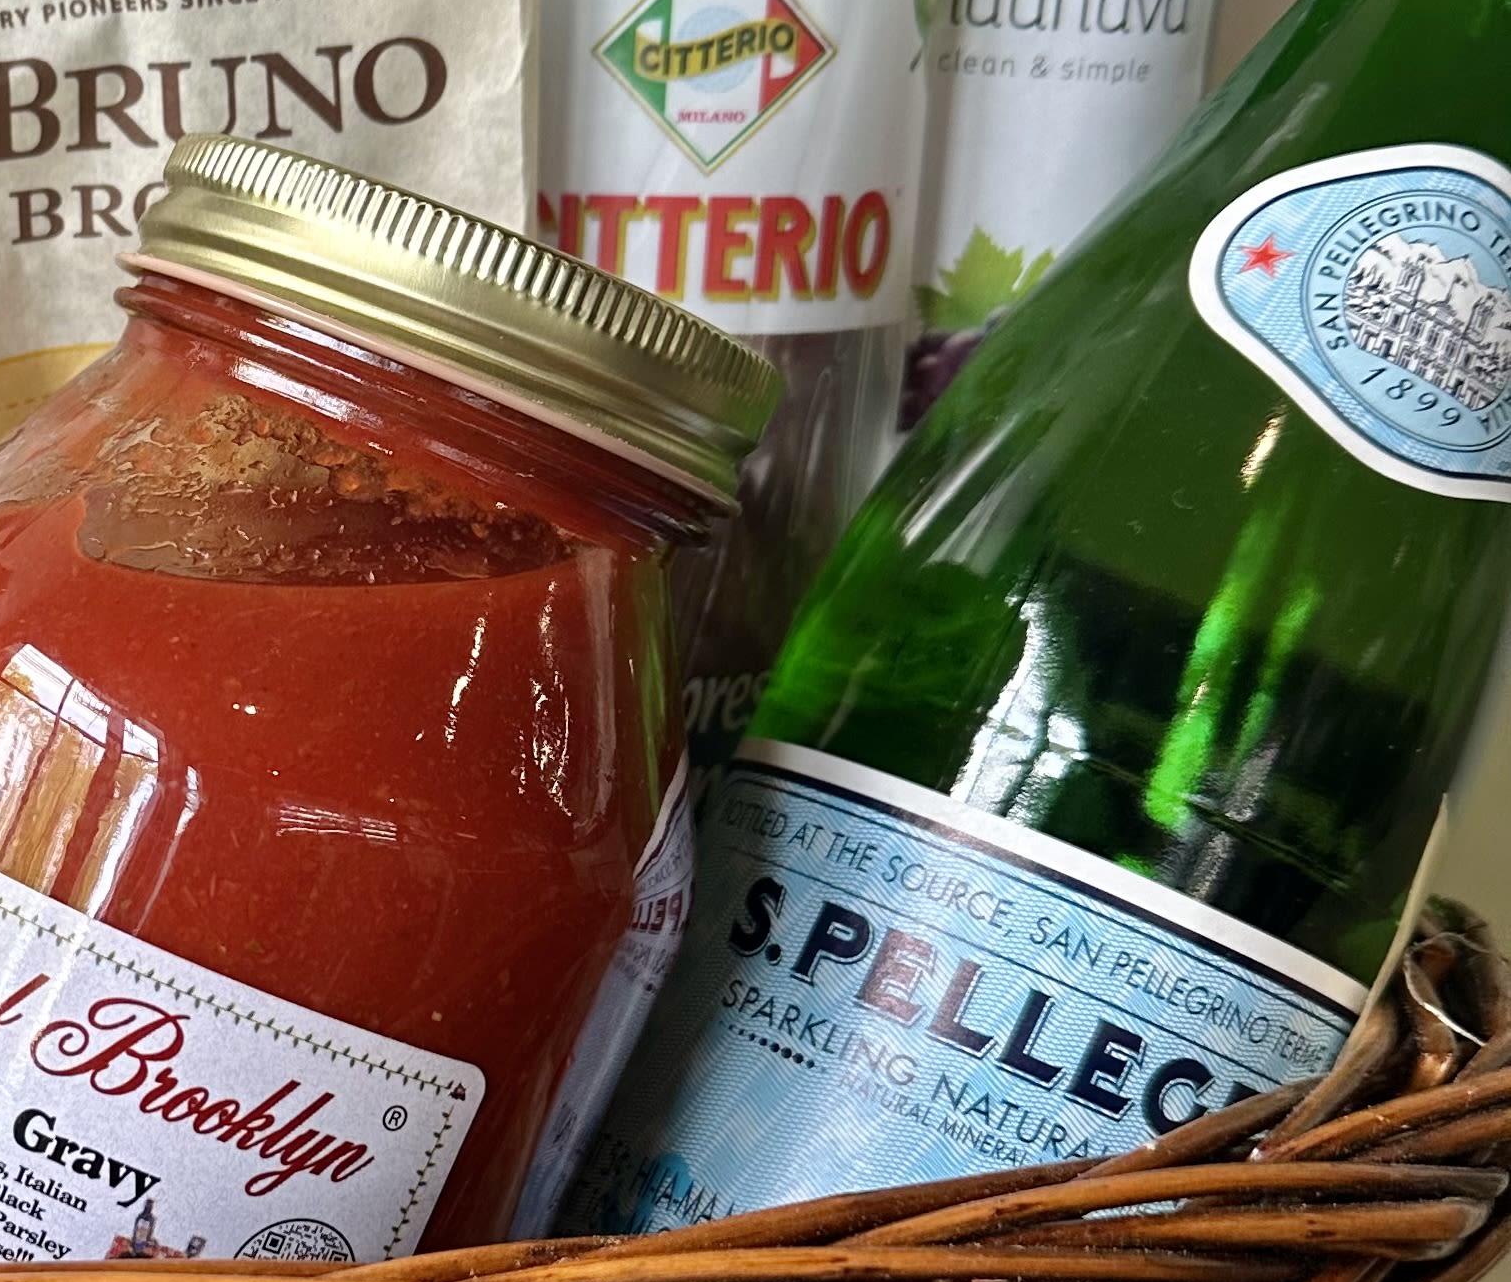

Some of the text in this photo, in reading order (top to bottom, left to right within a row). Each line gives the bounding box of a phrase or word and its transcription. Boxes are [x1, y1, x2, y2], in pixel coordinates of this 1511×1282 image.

[639, 23, 796, 76] CITTERIO
[939, 48, 1152, 84] clean & simple
[677, 108, 745, 124] MILANO
[1320, 202, 1480, 280] PELLEGRINO
[1315, 293, 1349, 351] SAN
[1360, 367, 1461, 428] 1899
[789, 822, 823, 849] AT
[826, 832, 877, 873] THE
[883, 856, 1016, 938] SOURCE,
[1030, 917, 1105, 967] SAN
[1109, 950, 1270, 1044] PELLEGRINO
[722, 980, 919, 1086] SPARKLING
[729, 877, 1264, 1135] S.PELLEG
[30, 996, 375, 1197] Brooklyn
[838, 1069, 932, 1128] NATURAL
[13, 1108, 161, 1207] Gravy
[14, 1165, 88, 1213] Italian
